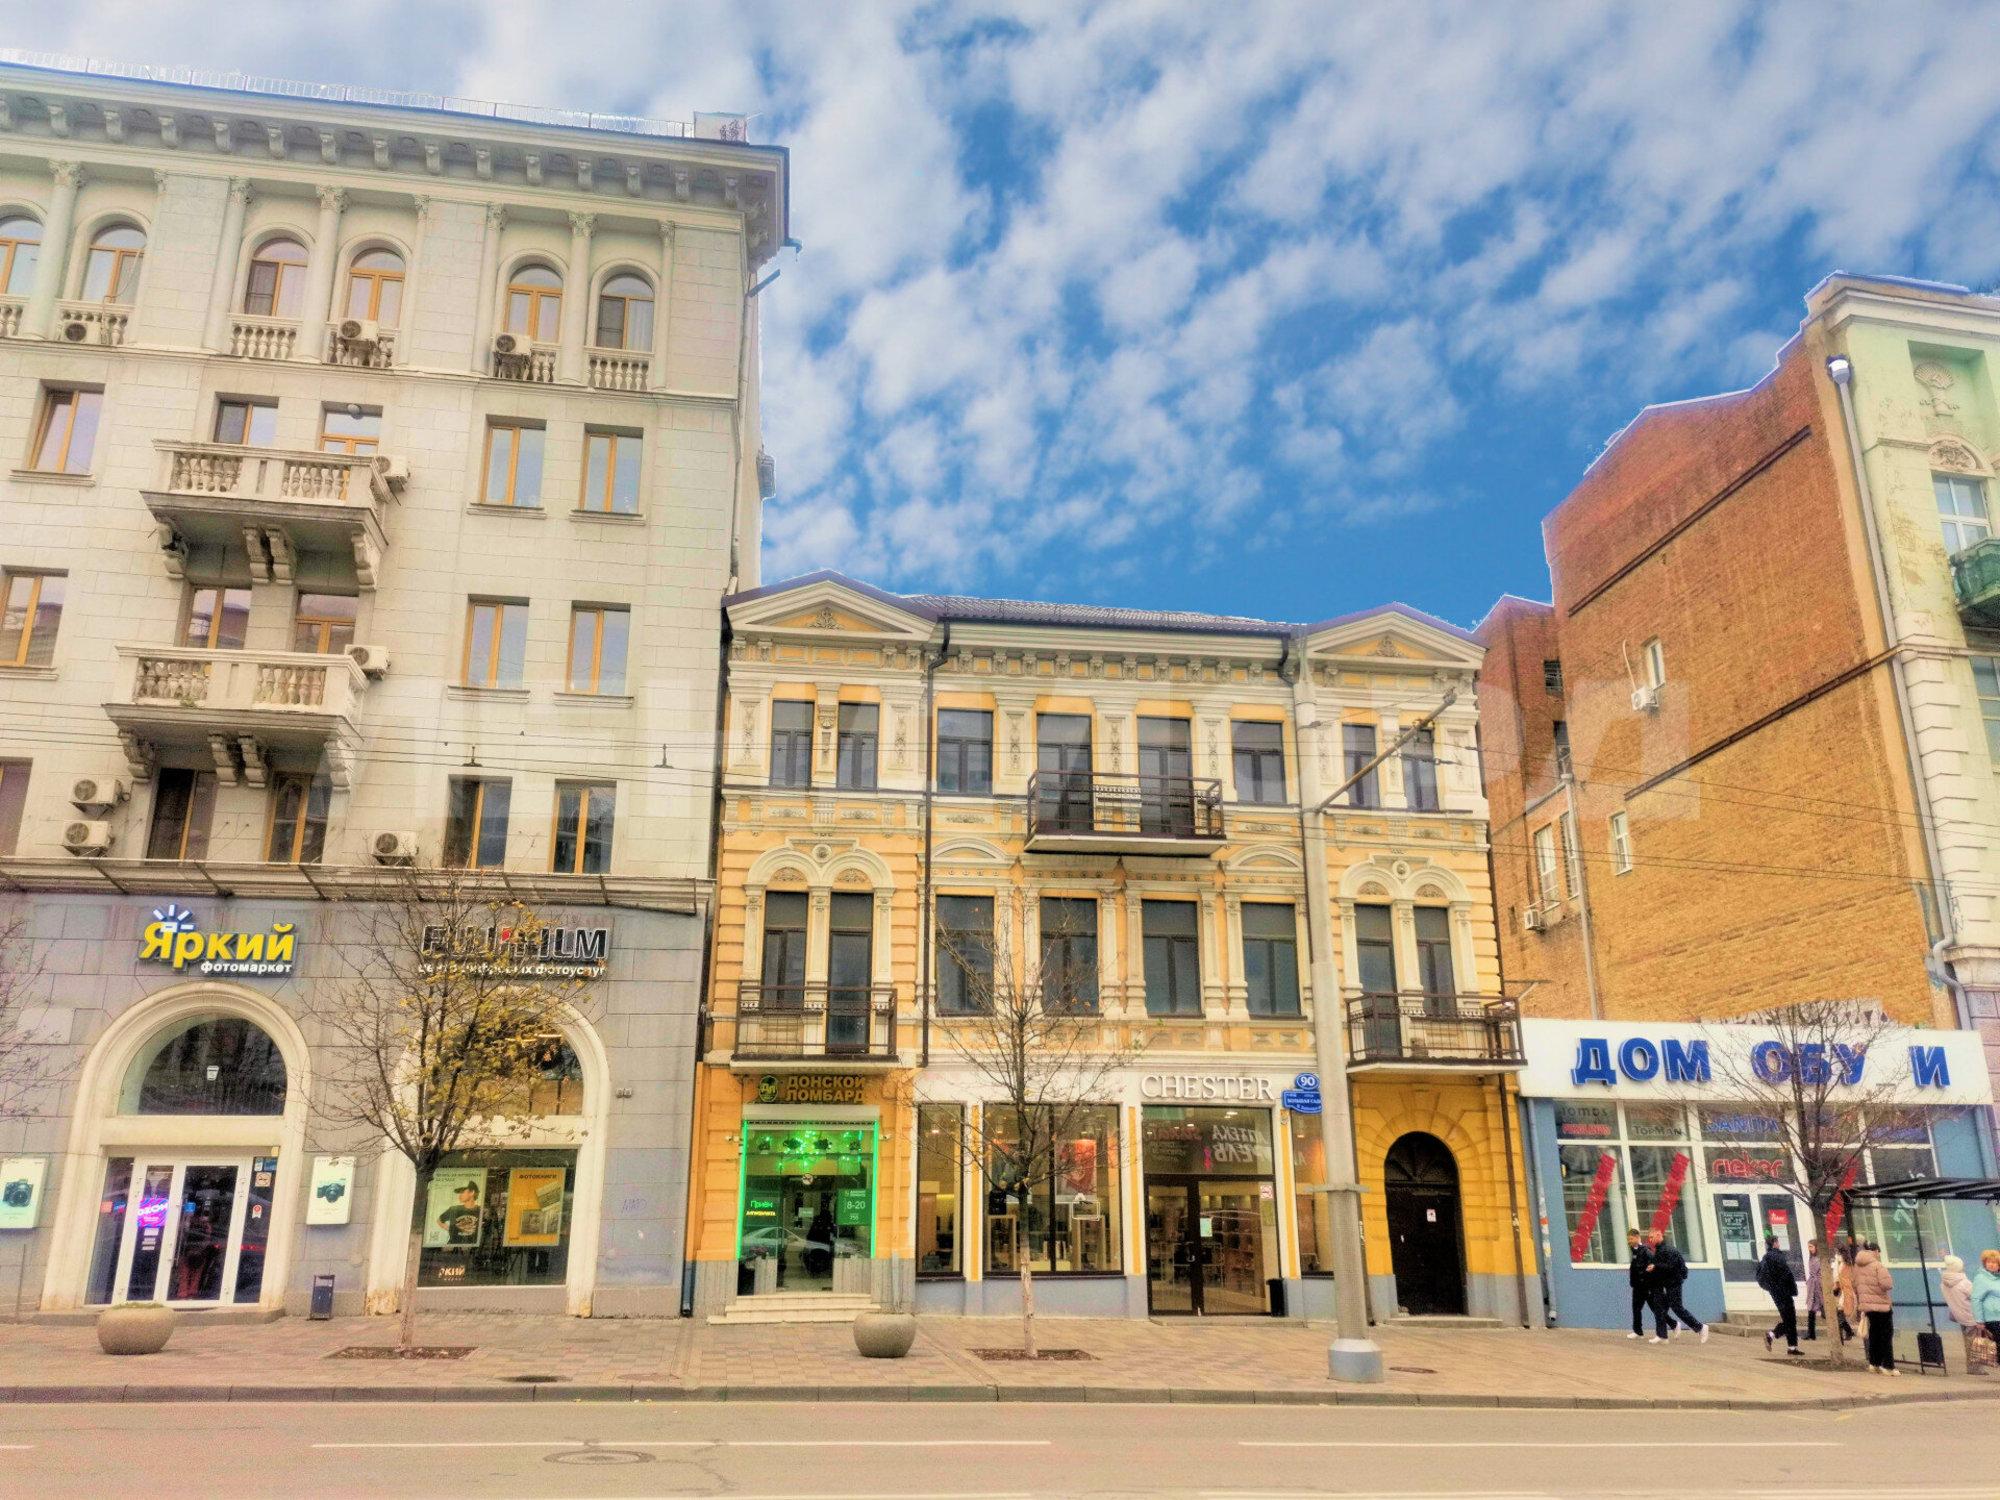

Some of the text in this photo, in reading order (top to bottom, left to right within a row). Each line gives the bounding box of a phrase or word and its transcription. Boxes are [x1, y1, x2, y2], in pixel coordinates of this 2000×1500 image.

[139, 921, 295, 969] Яркий
[200, 961, 292, 975] фотомаркет
[1571, 1037, 1713, 1086] ДОМ
[787, 1074, 866, 1089] ДОНСКОЙ
[1140, 1073, 1277, 1100] CHESTER
[1300, 1076, 1316, 1086] 90
[786, 1090, 865, 1103] ЛОМБАРД
[847, 1201, 866, 1210] 8-20
